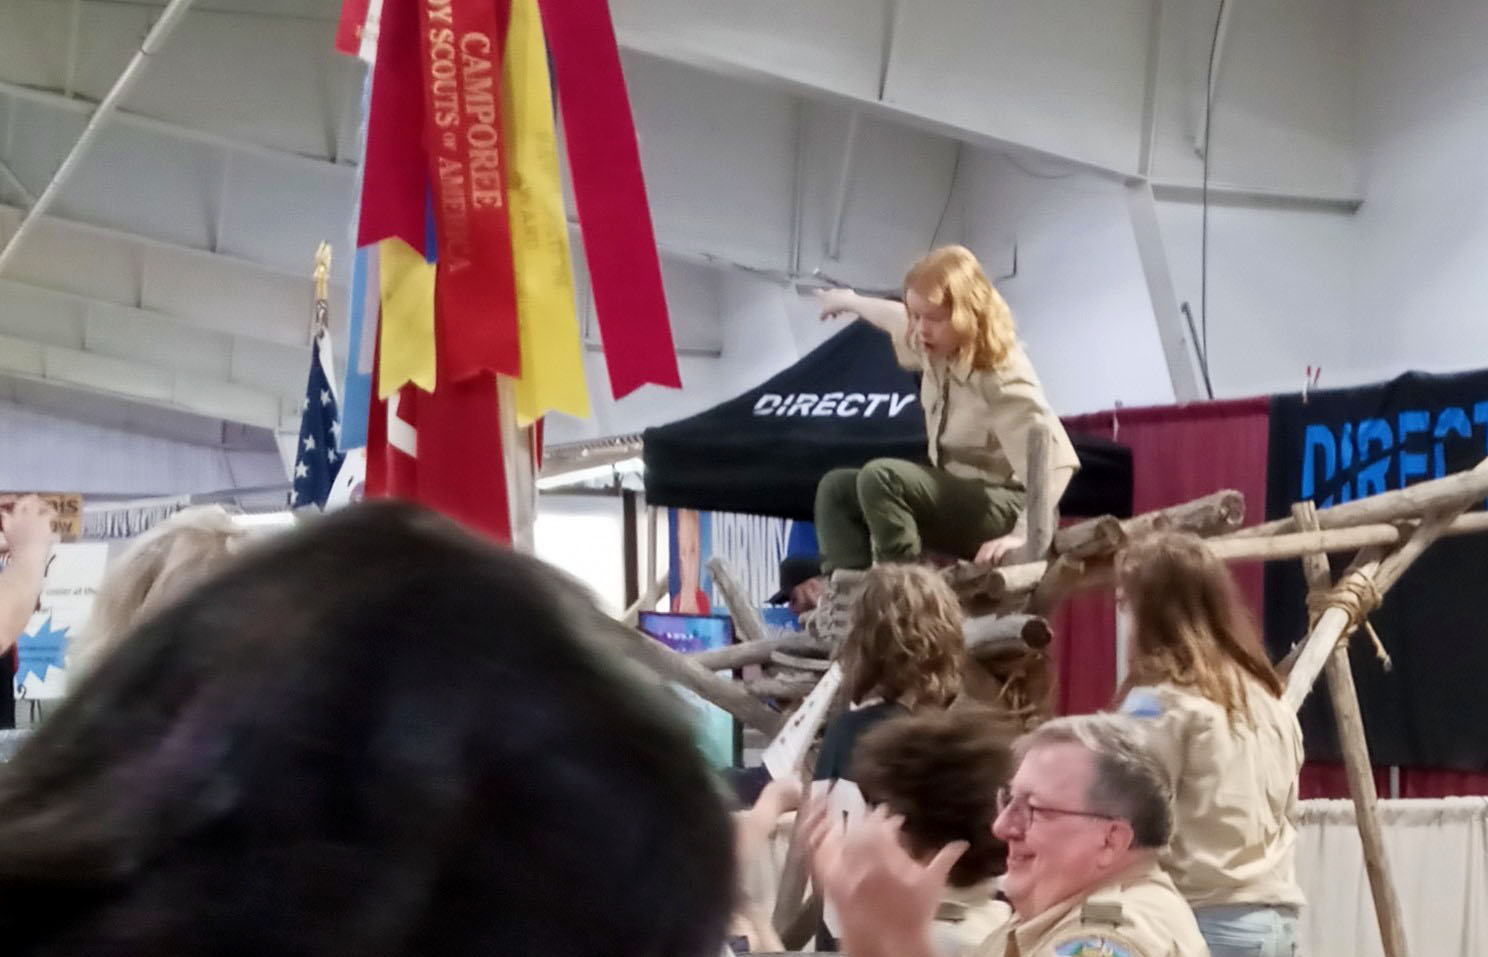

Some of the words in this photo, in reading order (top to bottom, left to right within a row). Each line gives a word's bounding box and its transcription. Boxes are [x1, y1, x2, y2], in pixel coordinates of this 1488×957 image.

[429, 28, 460, 128] SCOUTS
[460, 31, 503, 208] CAMPOREE
[753, 391, 917, 417] DIRECTV
